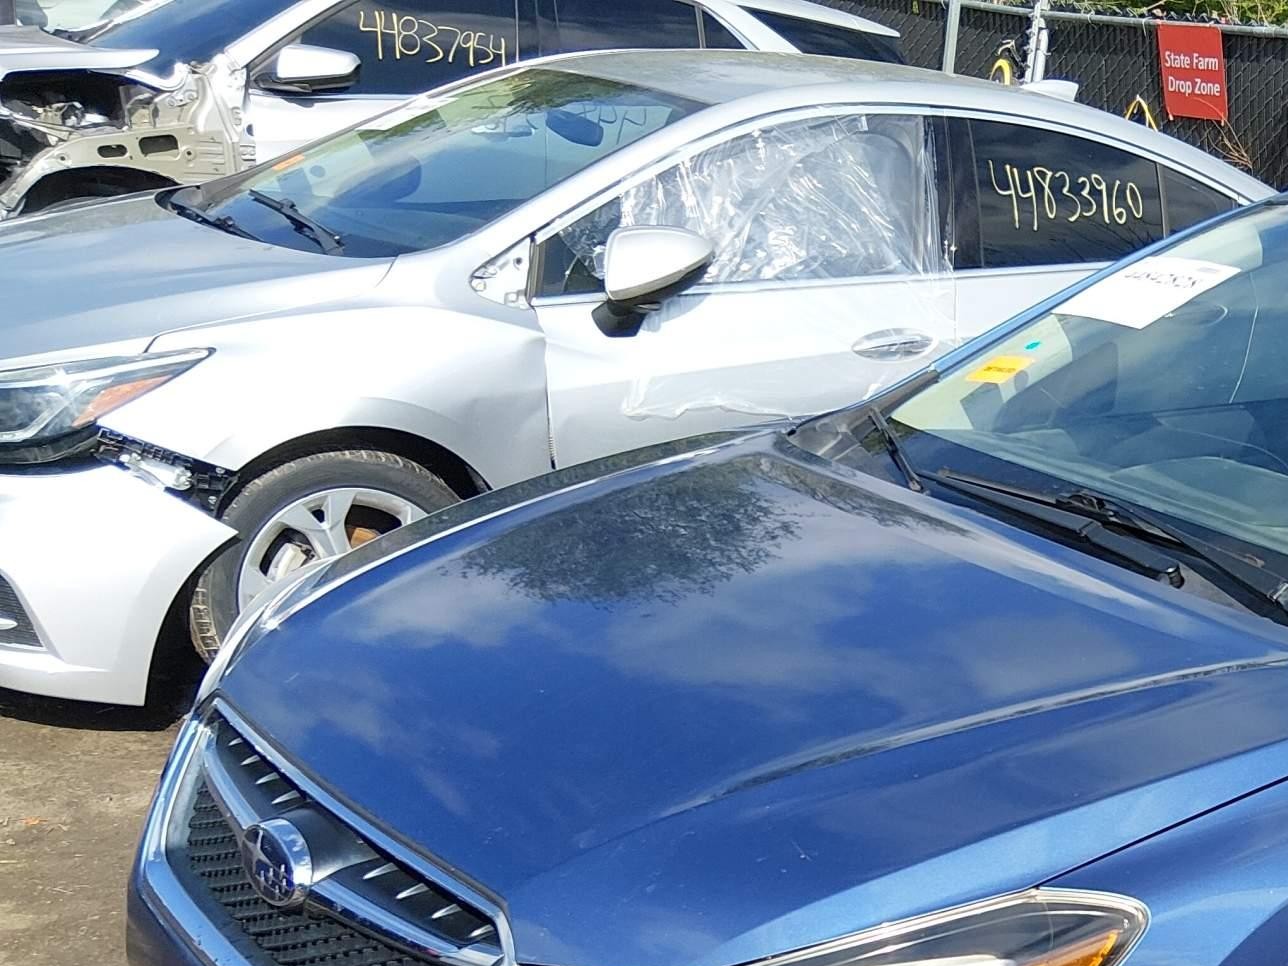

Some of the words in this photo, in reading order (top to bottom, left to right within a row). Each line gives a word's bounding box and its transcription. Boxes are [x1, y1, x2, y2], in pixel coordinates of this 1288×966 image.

[360, 11, 506, 67] 44837954
[1164, 51, 1191, 69] State
[1193, 52, 1219, 71] Farm
[1168, 75, 1193, 97] Drop
[1194, 78, 1221, 96] Zone
[988, 159, 1143, 231] 44833960
